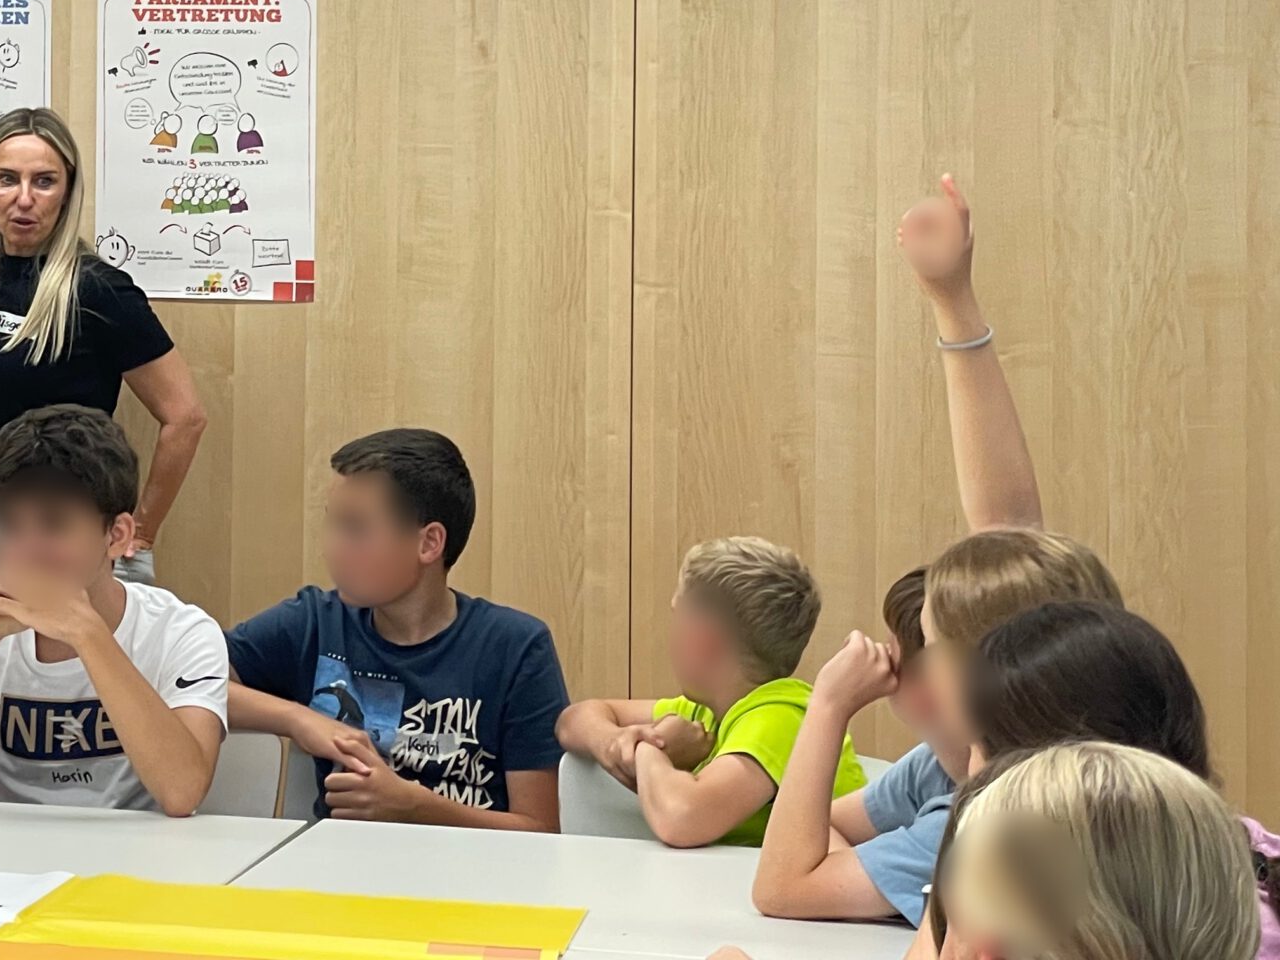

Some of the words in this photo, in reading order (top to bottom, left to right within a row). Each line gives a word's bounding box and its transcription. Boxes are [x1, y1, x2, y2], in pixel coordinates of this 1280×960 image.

[132, 8, 282, 23] VERTRETUNG
[188, 159, 197, 169] 3
[6, 705, 123, 754] NIKE
[396, 697, 482, 745] STAY
[408, 736, 440, 756] Korbi
